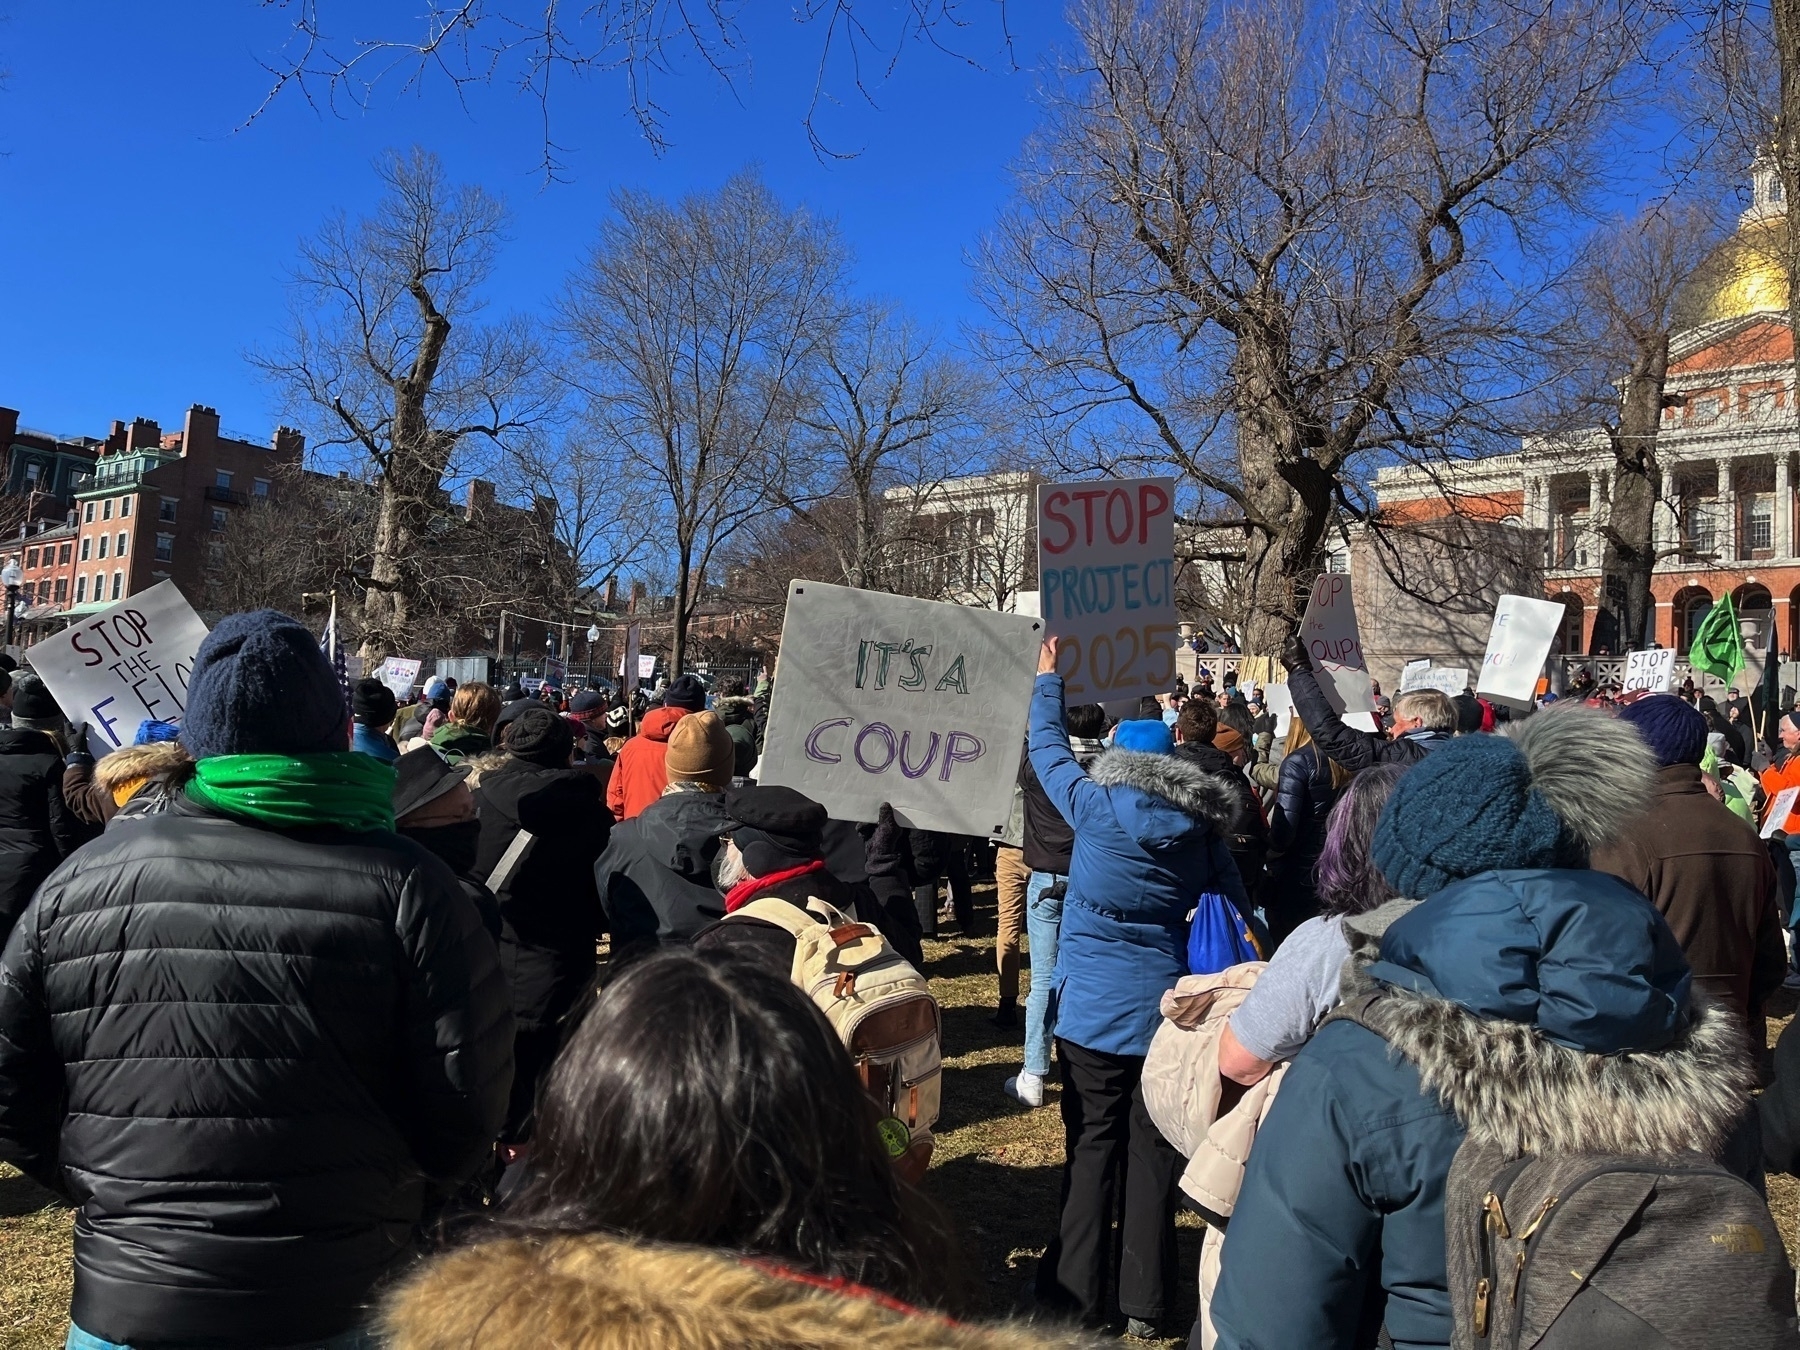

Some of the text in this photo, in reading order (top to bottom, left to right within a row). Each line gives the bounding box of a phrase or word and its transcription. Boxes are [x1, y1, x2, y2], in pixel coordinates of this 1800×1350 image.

[1041, 484, 1169, 554] STOP
[1043, 558, 1173, 620] PROJECT
[1313, 577, 1343, 607] TOP
[71, 609, 153, 667] STOP
[1309, 617, 1325, 631] the
[108, 650, 161, 683] THE
[855, 638, 970, 694] IT'S A
[1057, 624, 1176, 695] 2025
[1627, 675, 1663, 691] COUP
[1630, 651, 1669, 669] STOP
[1641, 667, 1657, 676] THE
[91, 655, 196, 747] FELO
[804, 717, 987, 782] COUP
